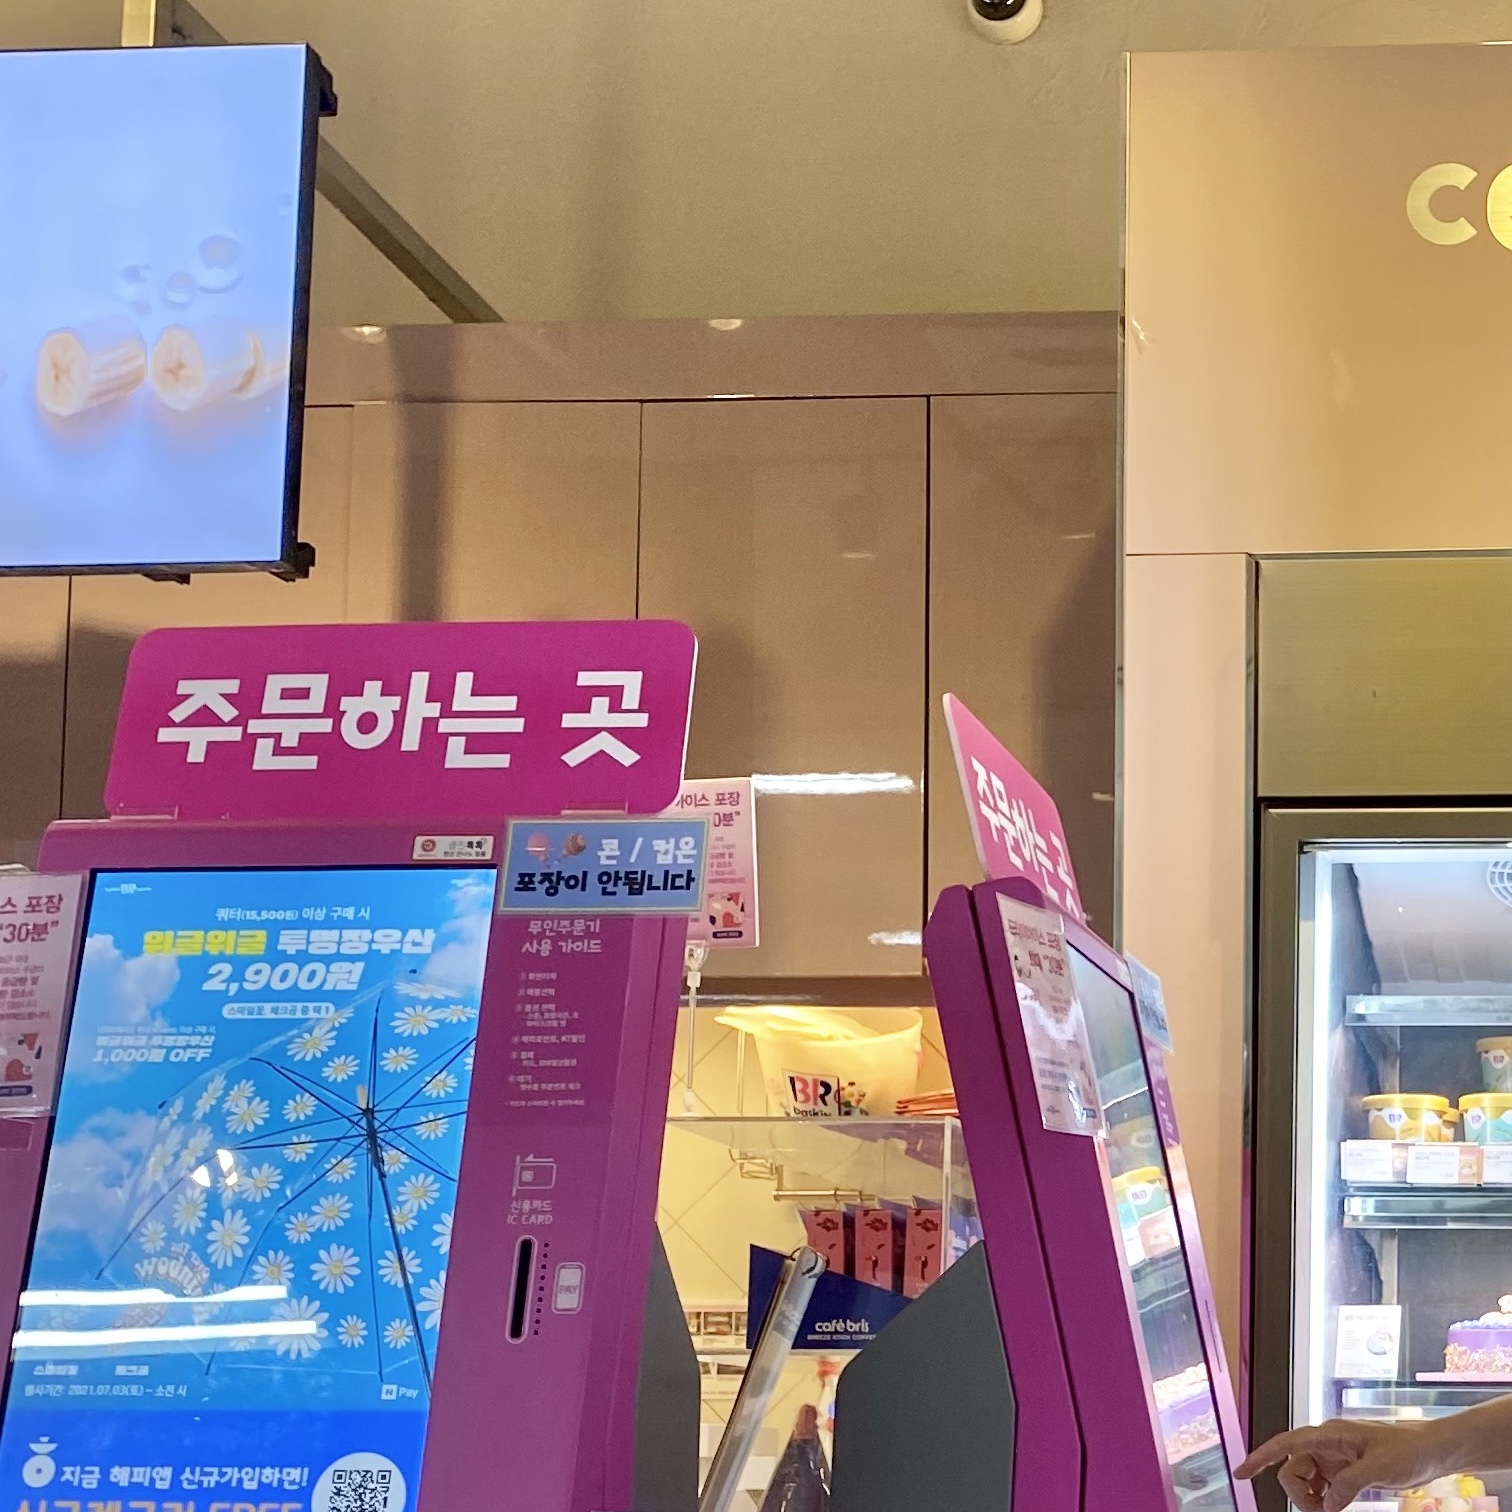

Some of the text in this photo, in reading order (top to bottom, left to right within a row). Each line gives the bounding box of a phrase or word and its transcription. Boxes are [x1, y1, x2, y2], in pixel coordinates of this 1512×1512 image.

[157, 671, 650, 770] 주문하는 곳
[714, 791, 741, 807] 포장
[597, 838, 621, 865] 콘
[652, 836, 698, 865] 컵은
[514, 869, 696, 897] 포장이 안됩니다
[24, 893, 64, 915] 포장
[302, 906, 325, 920] 이상
[330, 906, 356, 920] 구매
[357, 906, 371, 921] 시
[527, 918, 601, 936] 무인주문기
[276, 928, 436, 955] 투명장우산
[521, 938, 603, 957] 사용 가이드
[201, 961, 366, 997] 2,900원
[168, 1047, 213, 1063] OFF
[788, 1076, 832, 1106] BR
[510, 1200, 553, 1213] 신용카드
[506, 1214, 553, 1225] IC CARD
[558, 1284, 580, 1295] PAY
[846, 1318, 870, 1333] bris
[176, 1384, 188, 1398] 시
[399, 1387, 418, 1399] Pay
[61, 1466, 308, 1489] 지금 해피앱 신규가입하면!
